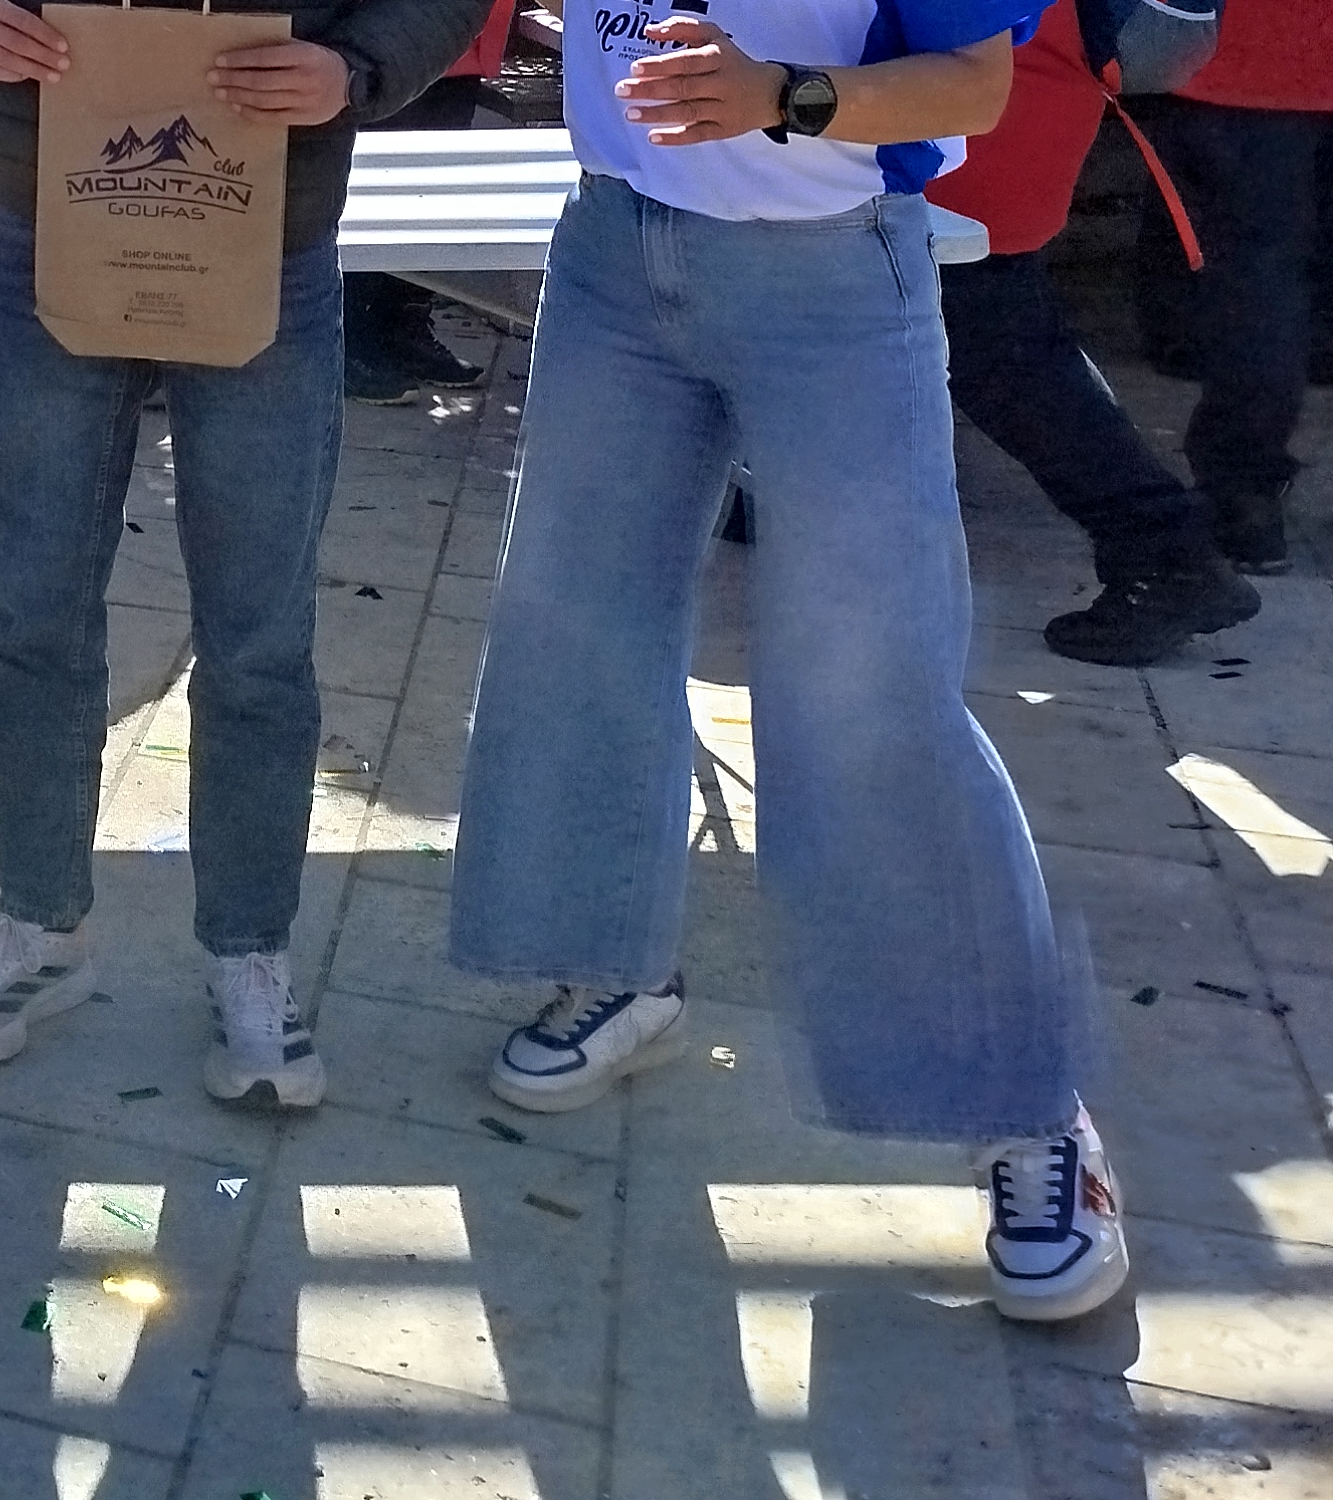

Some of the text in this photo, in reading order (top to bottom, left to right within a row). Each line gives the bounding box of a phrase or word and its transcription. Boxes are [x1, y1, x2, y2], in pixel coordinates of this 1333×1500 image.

[213, 158, 246, 177] club
[66, 176, 253, 207] MOUNTAIN
[108, 201, 206, 221] GOUFAS
[122, 249, 193, 262] SHOP ONLINE
